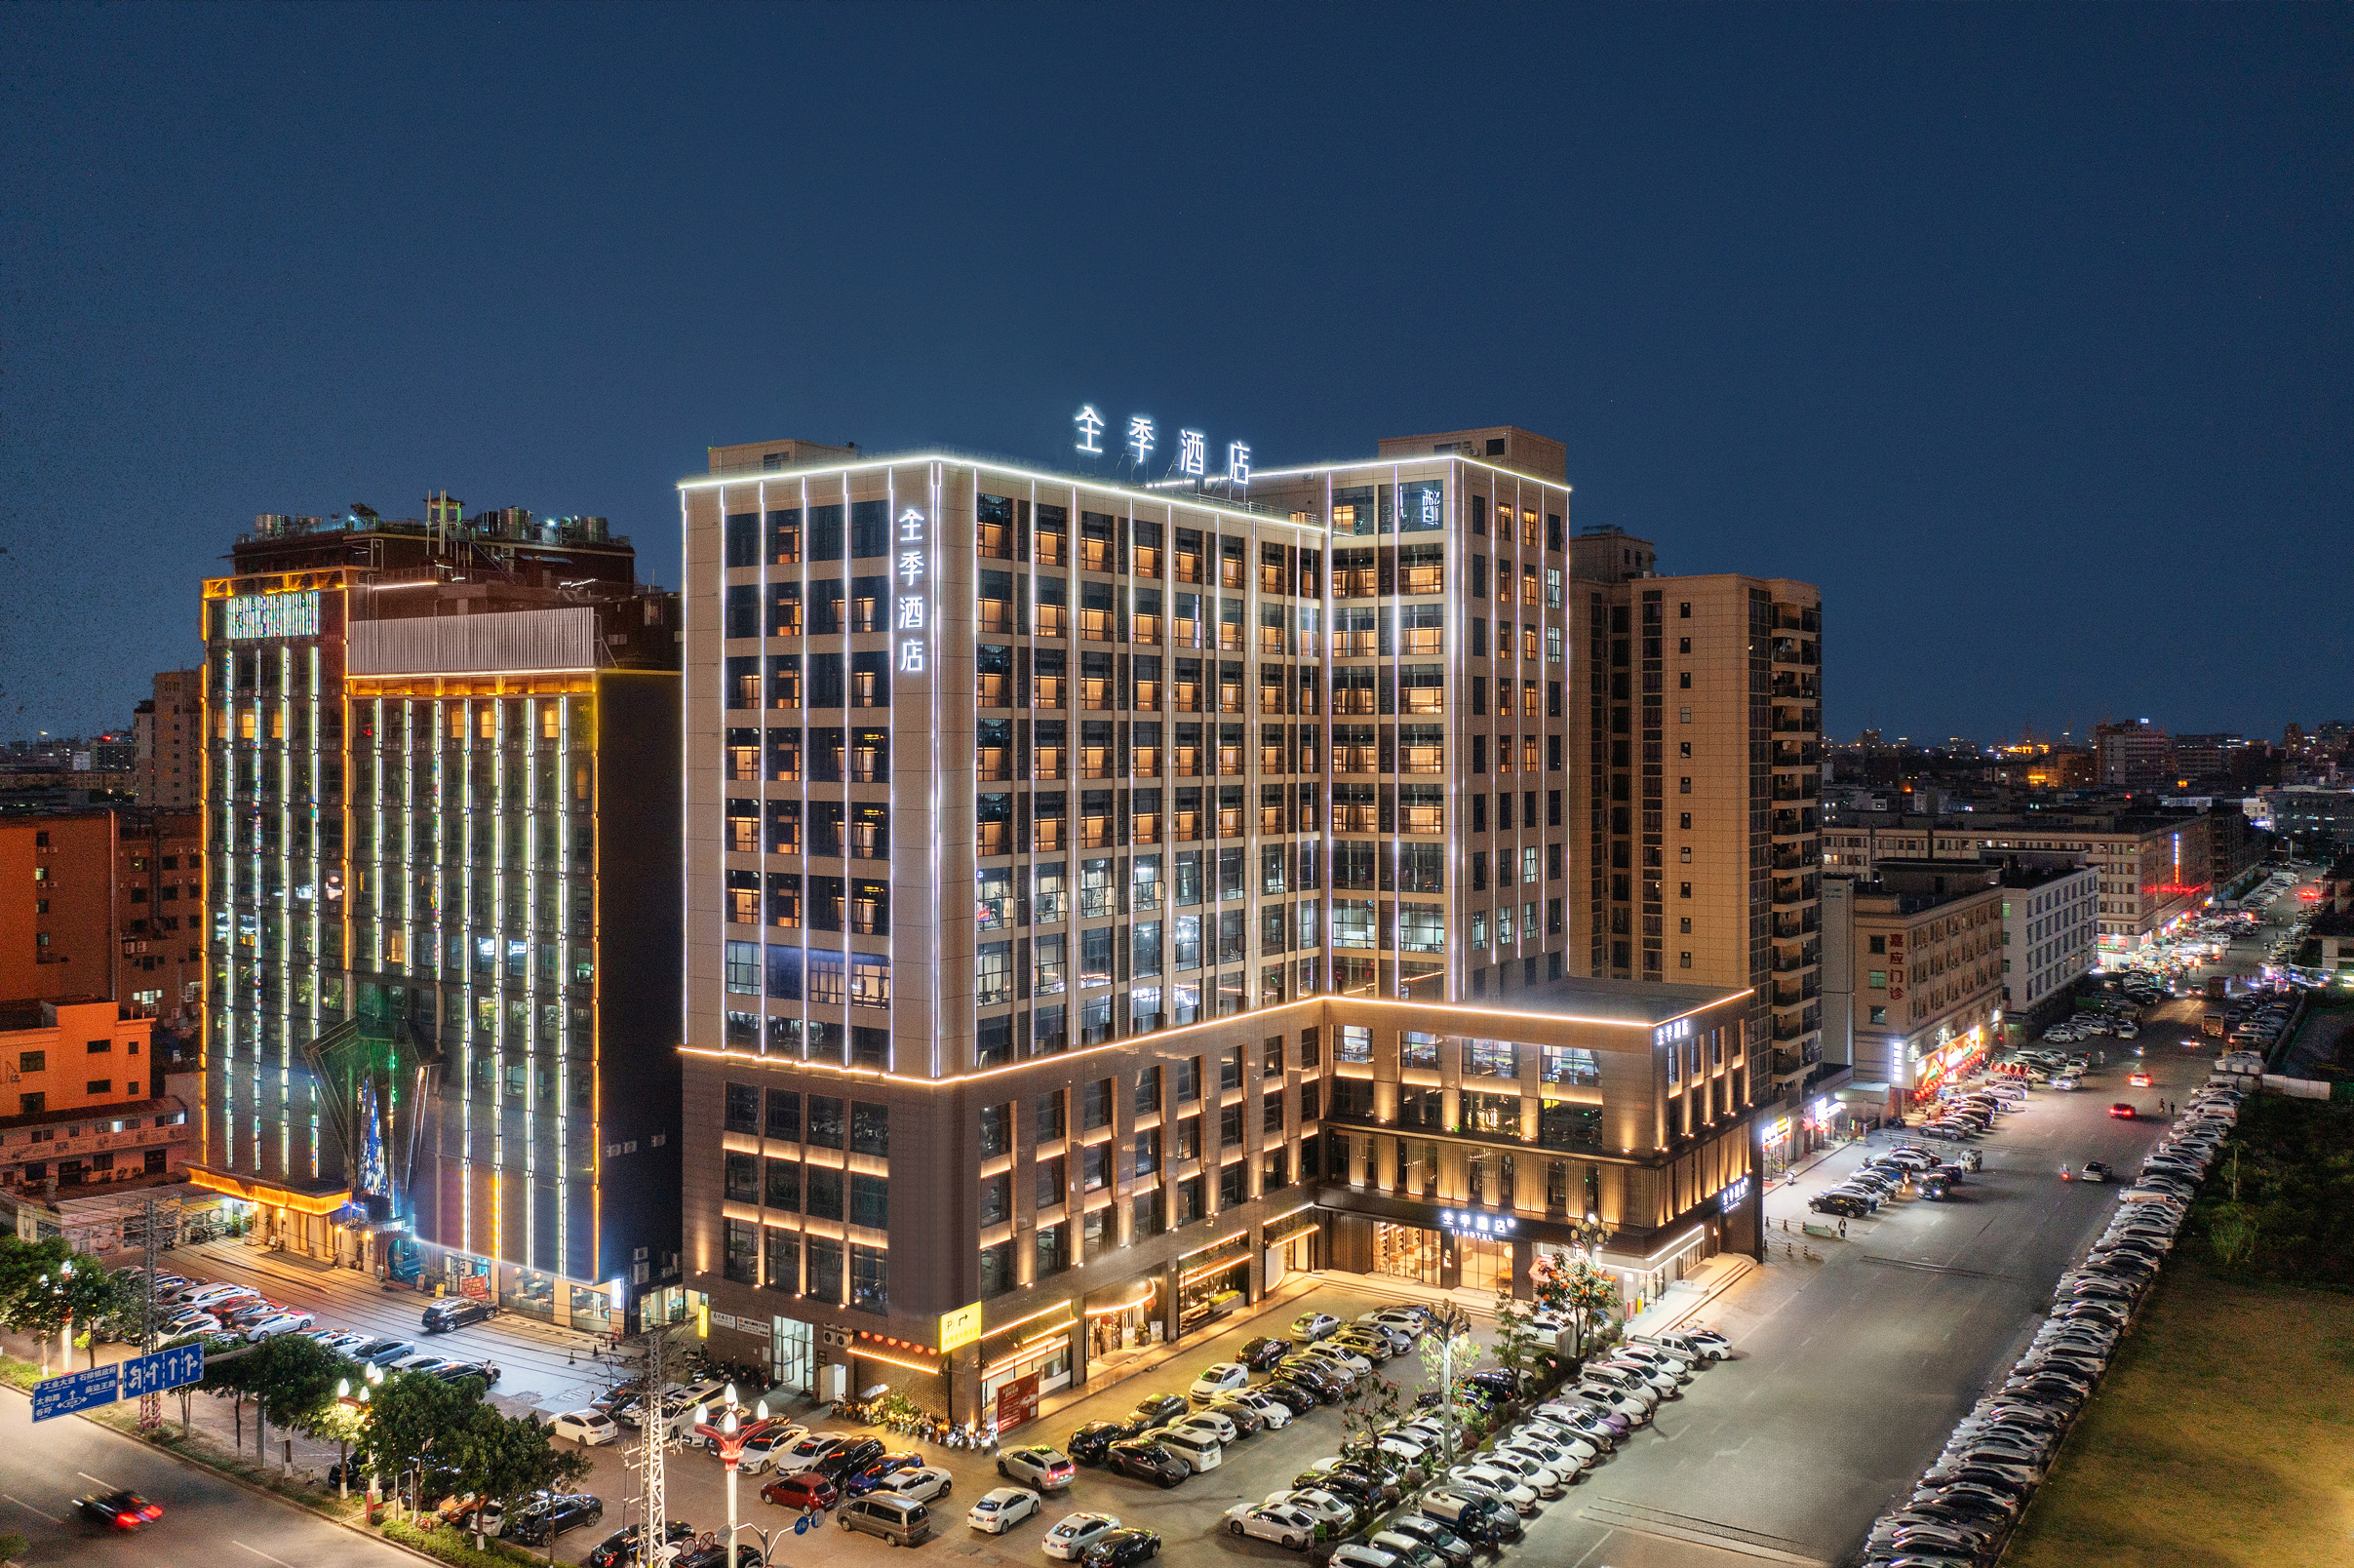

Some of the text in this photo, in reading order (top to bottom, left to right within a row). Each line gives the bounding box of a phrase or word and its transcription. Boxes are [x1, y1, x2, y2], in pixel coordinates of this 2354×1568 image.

[1075, 406, 1250, 485] 全季酒店
[898, 508, 925, 672] 全季酒店
[1889, 933, 1904, 1000] 嘉应门诊
[1657, 1019, 1689, 1045] 全季酒店
[1442, 1211, 1507, 1234] 全季酒店
[1463, 1230, 1494, 1242] HOTEL
[43, 1376, 76, 1391] 工业大道
[36, 1393, 60, 1405] 太和路
